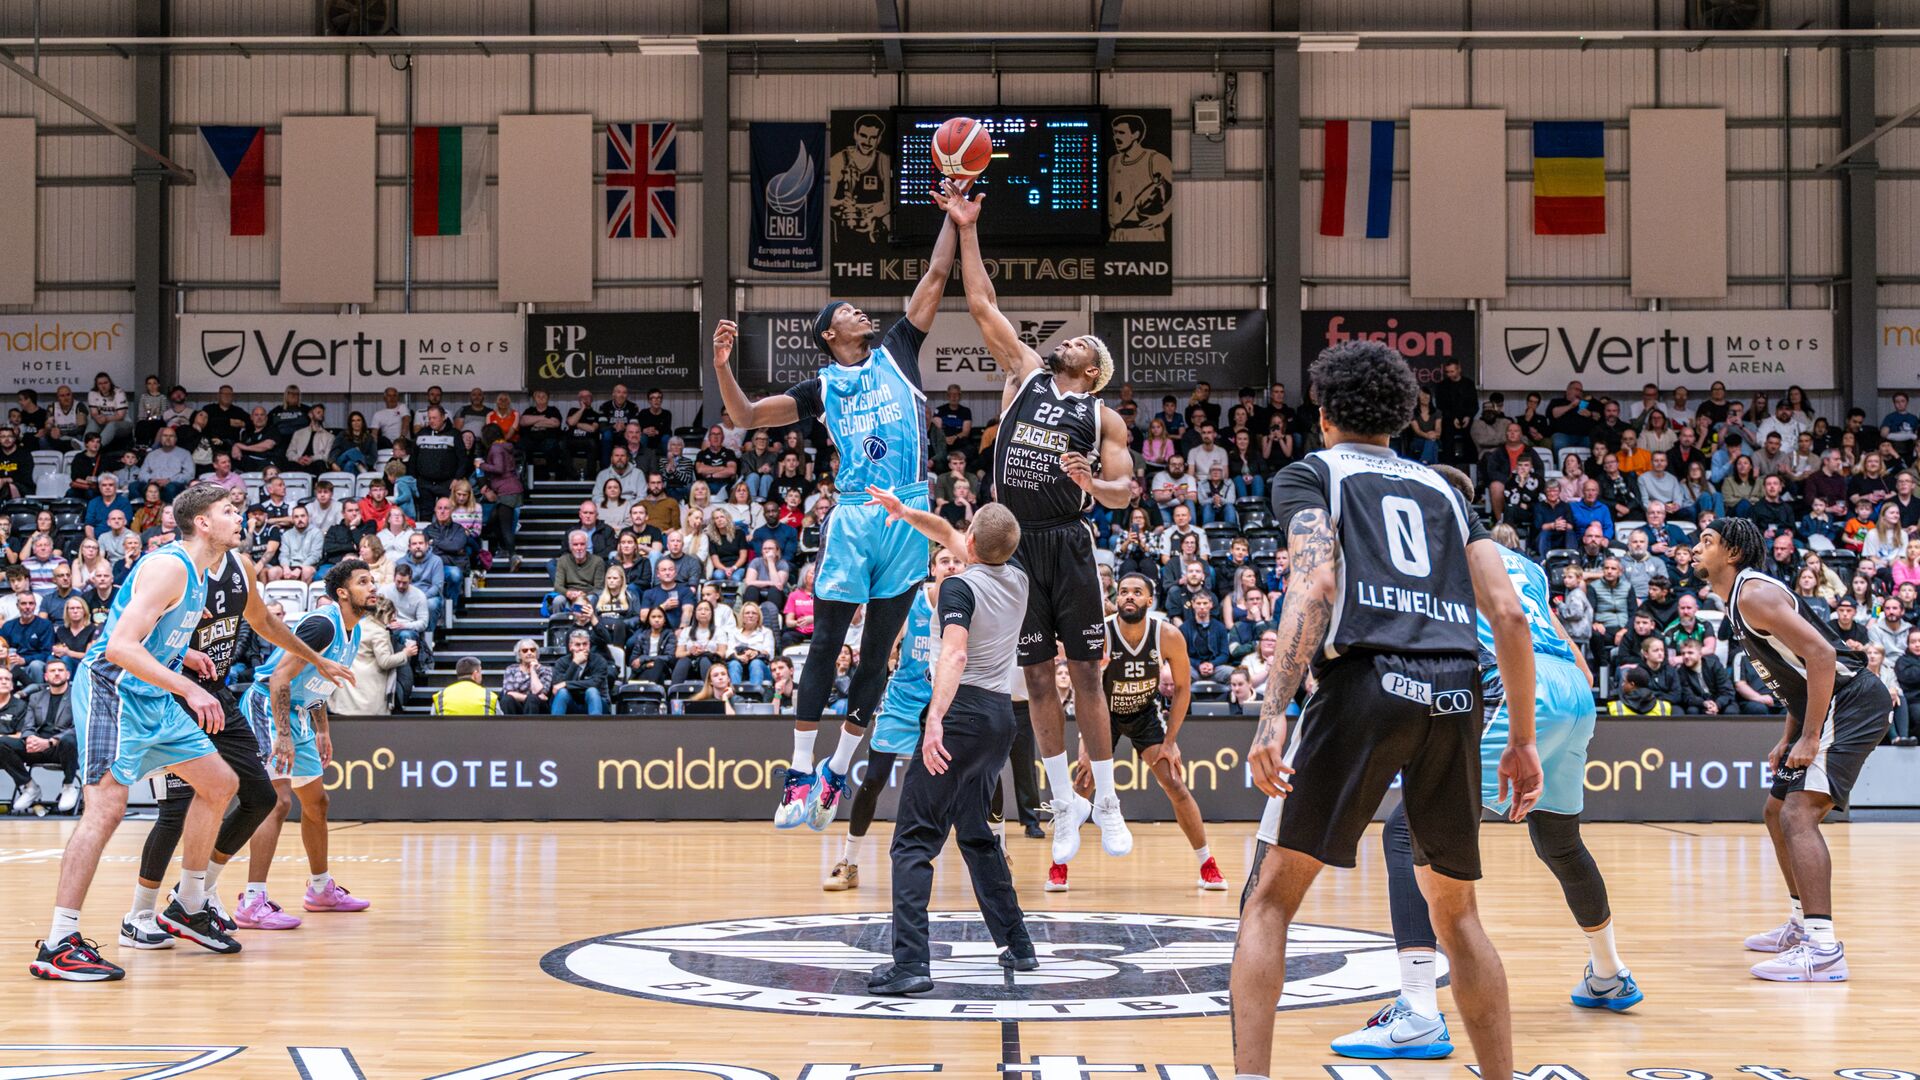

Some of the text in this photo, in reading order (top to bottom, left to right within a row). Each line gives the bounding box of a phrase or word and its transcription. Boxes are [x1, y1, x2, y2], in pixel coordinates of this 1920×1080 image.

[769, 216, 802, 236] ENBL
[758, 246, 814, 256] European North
[753, 258, 790, 268] Basketball
[833, 262, 873, 277] THE
[1104, 261, 1169, 276] STAND
[1131, 317, 1237, 332] NEWCASTLE
[418, 338, 509, 354] Motors
[544, 325, 587, 351] FP
[1131, 334, 1212, 349] COLLEGE
[1726, 336, 1819, 351] Motors
[253, 330, 406, 376] Vertu
[936, 346, 992, 356] NEWCAST
[1131, 351, 1229, 366] UNIVERSITY
[1557, 327, 1714, 374] Vertu
[22, 361, 72, 372] HOTEL
[595, 354, 675, 365] Fire Protect and
[776, 353, 832, 367] UNIVE
[1728, 361, 1786, 374] ARENA
[419, 363, 475, 376] ARENA
[595, 366, 688, 378] Compliance Group
[776, 369, 819, 383] CENT
[1131, 369, 1198, 383] CENTRE
[13, 376, 80, 386] NEWCASTLE
[861, 374, 871, 391] 11
[1034, 402, 1065, 426] 22
[1013, 423, 1068, 453] EAGLES
[1010, 446, 1065, 465] NEWCASTLE
[1008, 457, 1050, 473] COLLEGE
[1007, 468, 1058, 484] UNIVERSITY
[1007, 477, 1039, 491] CENTRE
[1381, 495, 1431, 578] 0
[215, 590, 226, 614] 2
[1358, 581, 1470, 625] LLEWELLYN
[200, 617, 239, 650] EAGLE
[1124, 661, 1145, 678] 25
[1114, 678, 1157, 694] EAGLES
[1390, 675, 1468, 713] PER CO
[401, 760, 559, 788] HOTELS
[598, 747, 792, 791] maldron
[1670, 761, 1774, 789] HOTE
